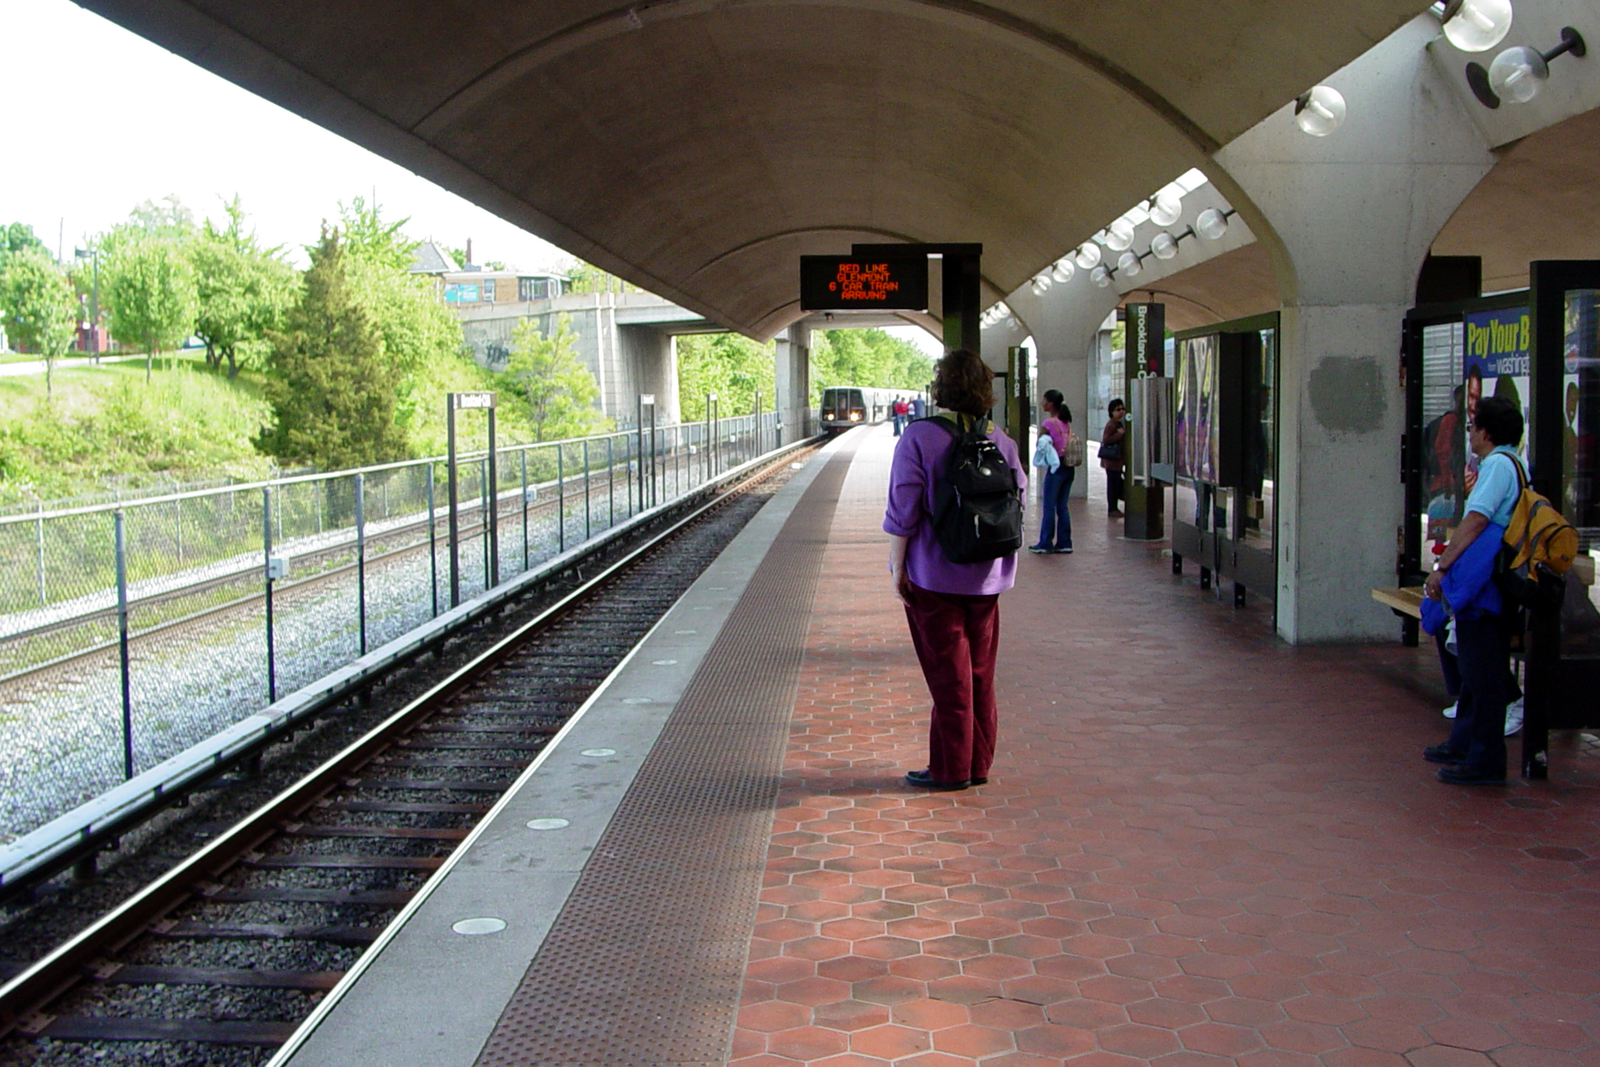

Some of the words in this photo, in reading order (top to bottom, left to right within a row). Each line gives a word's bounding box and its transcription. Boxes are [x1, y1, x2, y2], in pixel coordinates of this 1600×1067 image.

[839, 263, 860, 273] RED
[865, 263, 888, 273] LINE
[836, 272, 890, 282] GLENMONT
[828, 281, 837, 291] 6
[842, 281, 863, 291] CAR
[869, 281, 899, 291] TRAIN
[841, 290, 887, 300] ARRIVING
[1137, 305, 1148, 364] Brookland
[1467, 322, 1490, 359] Pay
[1489, 318, 1520, 354] Your
[1519, 314, 1530, 351] B
